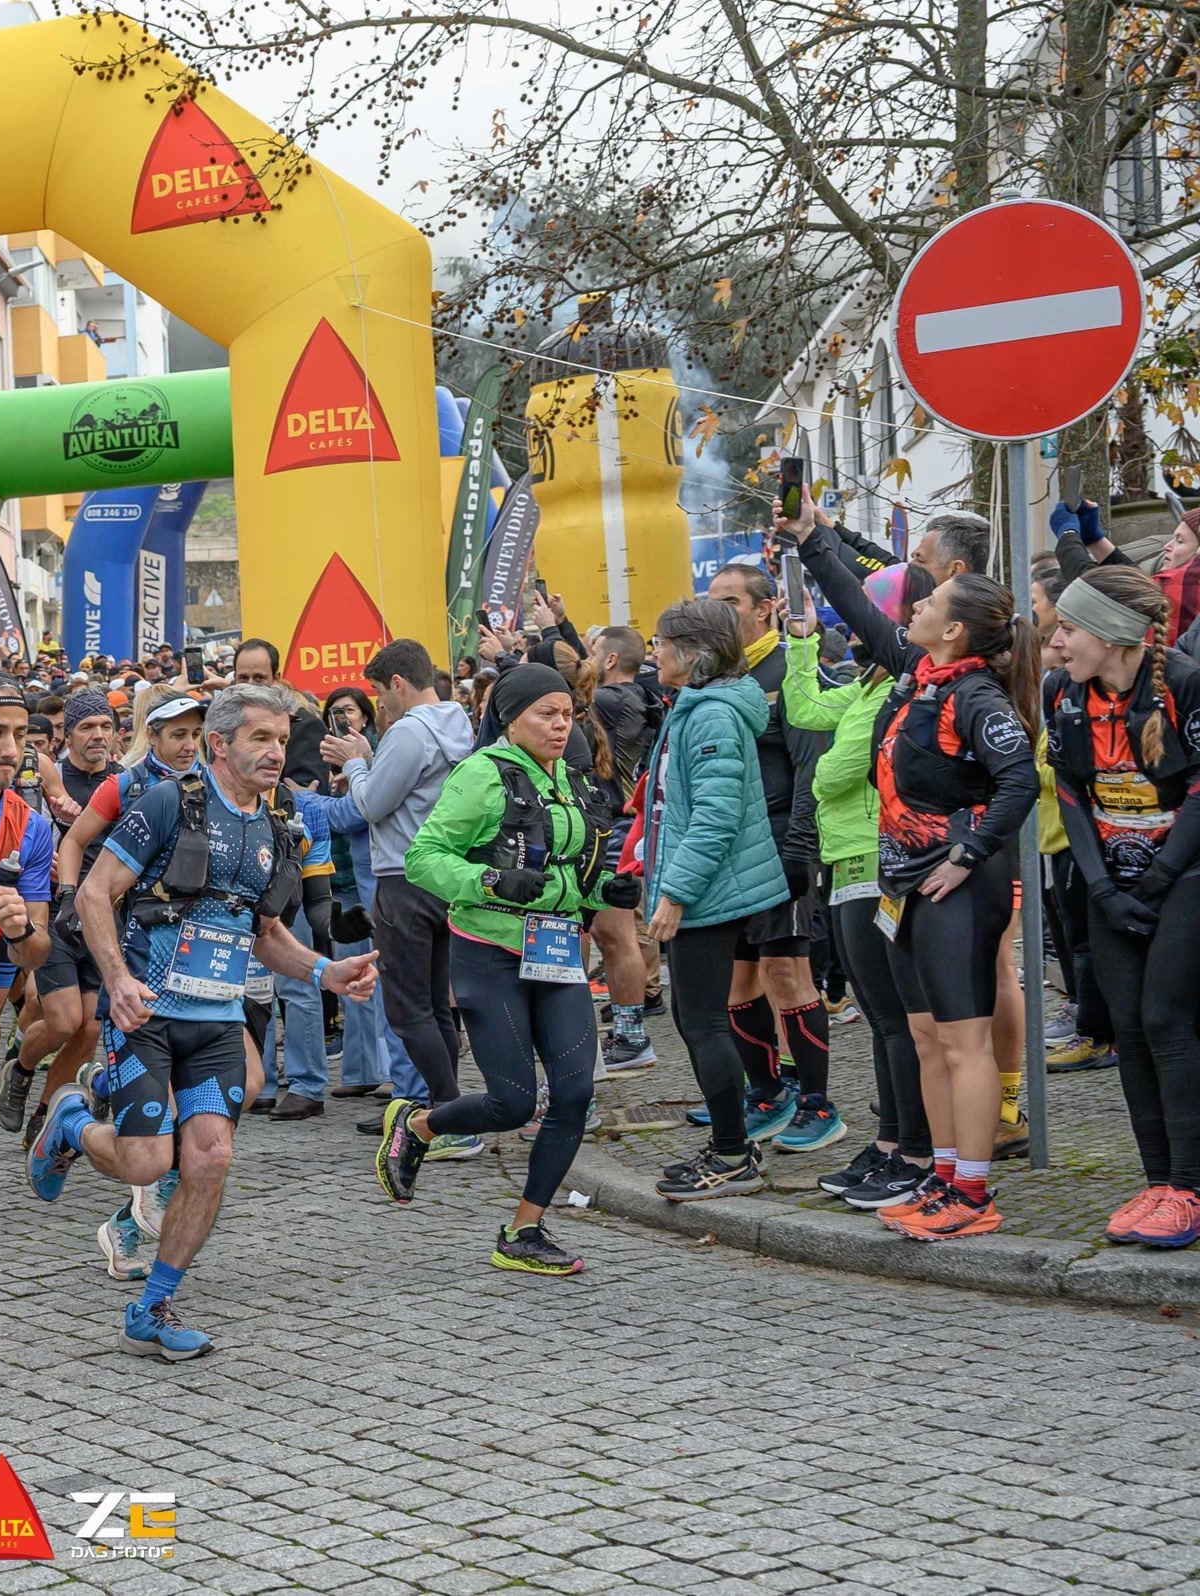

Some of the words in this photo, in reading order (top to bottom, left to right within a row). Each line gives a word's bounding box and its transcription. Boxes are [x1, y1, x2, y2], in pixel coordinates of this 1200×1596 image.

[152, 164, 242, 198] DELTA
[176, 194, 219, 209] CAFÉS
[287, 406, 376, 438] DELTA
[68, 423, 176, 457] AVENTURA
[309, 437, 352, 450] CAFÉS
[825, 493, 836, 507] P
[87, 509, 102, 517] 808
[103, 508, 120, 517] 246
[123, 508, 138, 517] 246
[489, 493, 529, 605] PORTEVIDRO
[143, 556, 161, 654] BEACTIVE
[322, 672, 365, 684] CAFÉS
[1101, 796, 1142, 805] Santana
[199, 930, 235, 943] TRILHOS
[213, 948, 232, 959] 1362
[210, 960, 228, 972] Pais
